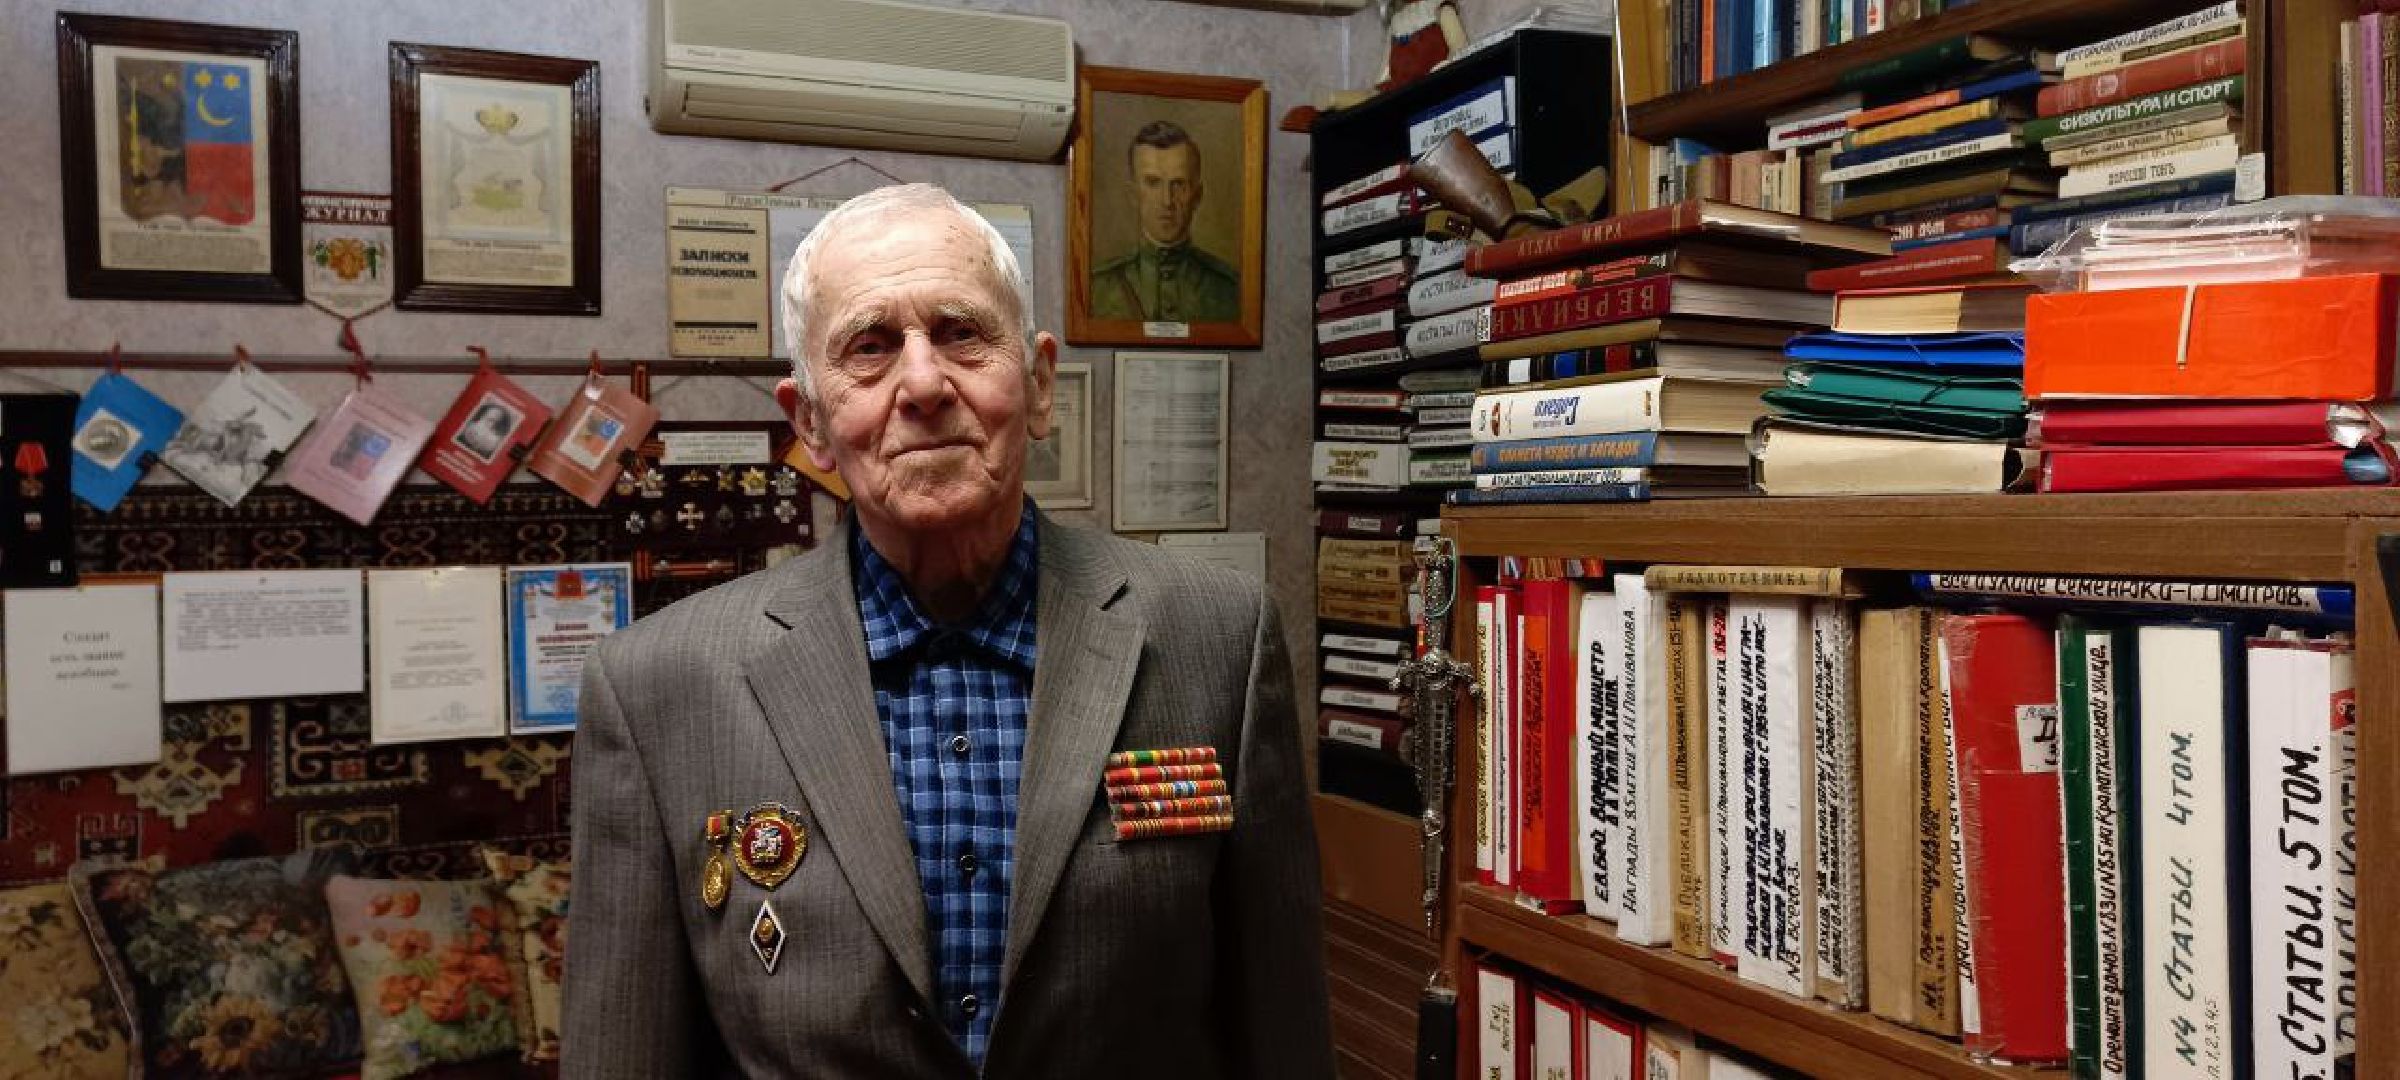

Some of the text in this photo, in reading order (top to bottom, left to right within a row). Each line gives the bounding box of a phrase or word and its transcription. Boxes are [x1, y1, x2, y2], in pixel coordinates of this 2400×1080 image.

[2059, 80, 2234, 130] ФИЗКУЛЬТУРА И СПОРТ
[1581, 222, 1623, 242] МИРА
[679, 248, 750, 263] ЗАПИСКИ
[1676, 572, 1808, 587] РАДИОТЕХНИКА
[1590, 641, 1605, 730] МИНИСТР
[2277, 885, 2327, 1057] СТАТЬИ.
